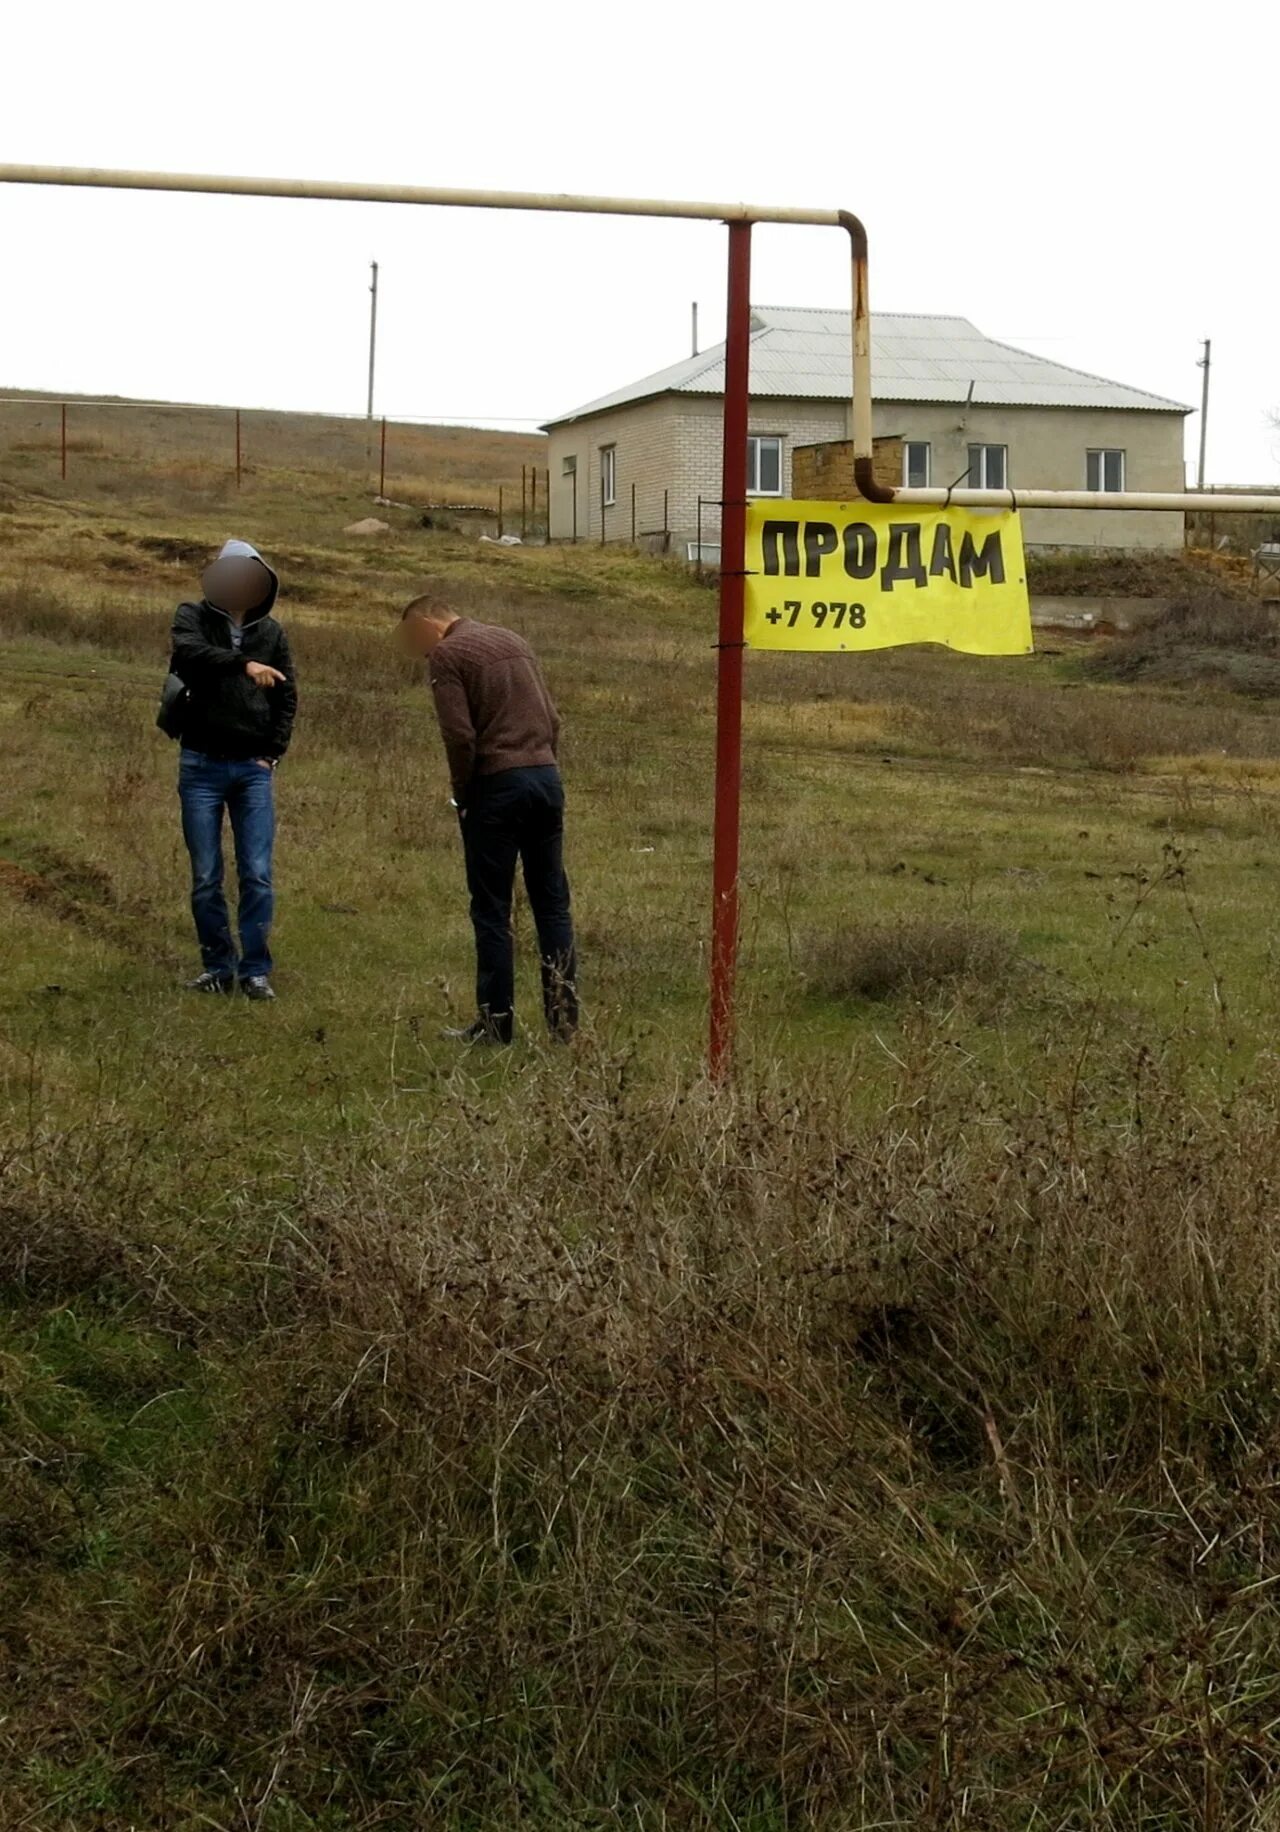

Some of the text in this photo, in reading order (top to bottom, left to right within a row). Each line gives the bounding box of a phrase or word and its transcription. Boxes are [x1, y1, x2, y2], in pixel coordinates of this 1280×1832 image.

[762, 520, 1006, 592] ПРОДАМ
[765, 601, 867, 629] +7 978
